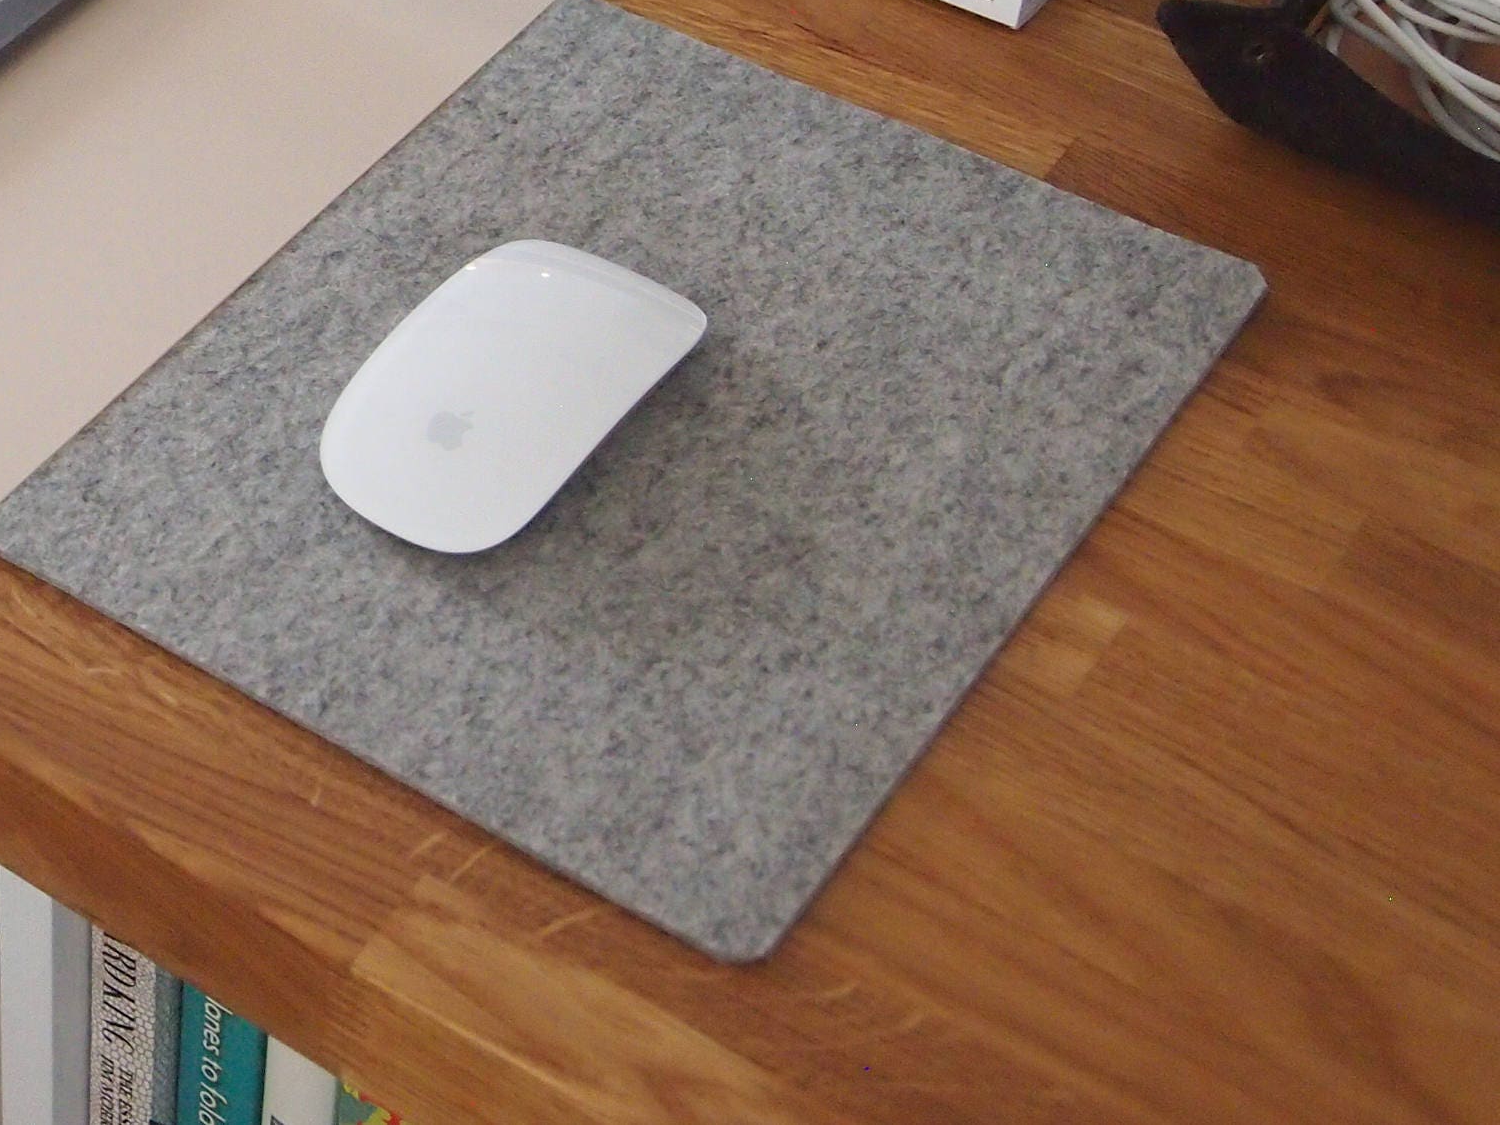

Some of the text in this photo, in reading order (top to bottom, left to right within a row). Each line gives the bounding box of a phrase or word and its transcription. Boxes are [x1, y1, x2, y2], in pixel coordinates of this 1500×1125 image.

[101, 980, 137, 1055] KING
[100, 1054, 114, 1083] JIM
[118, 1066, 133, 1100] THE
[201, 1056, 223, 1082] to
